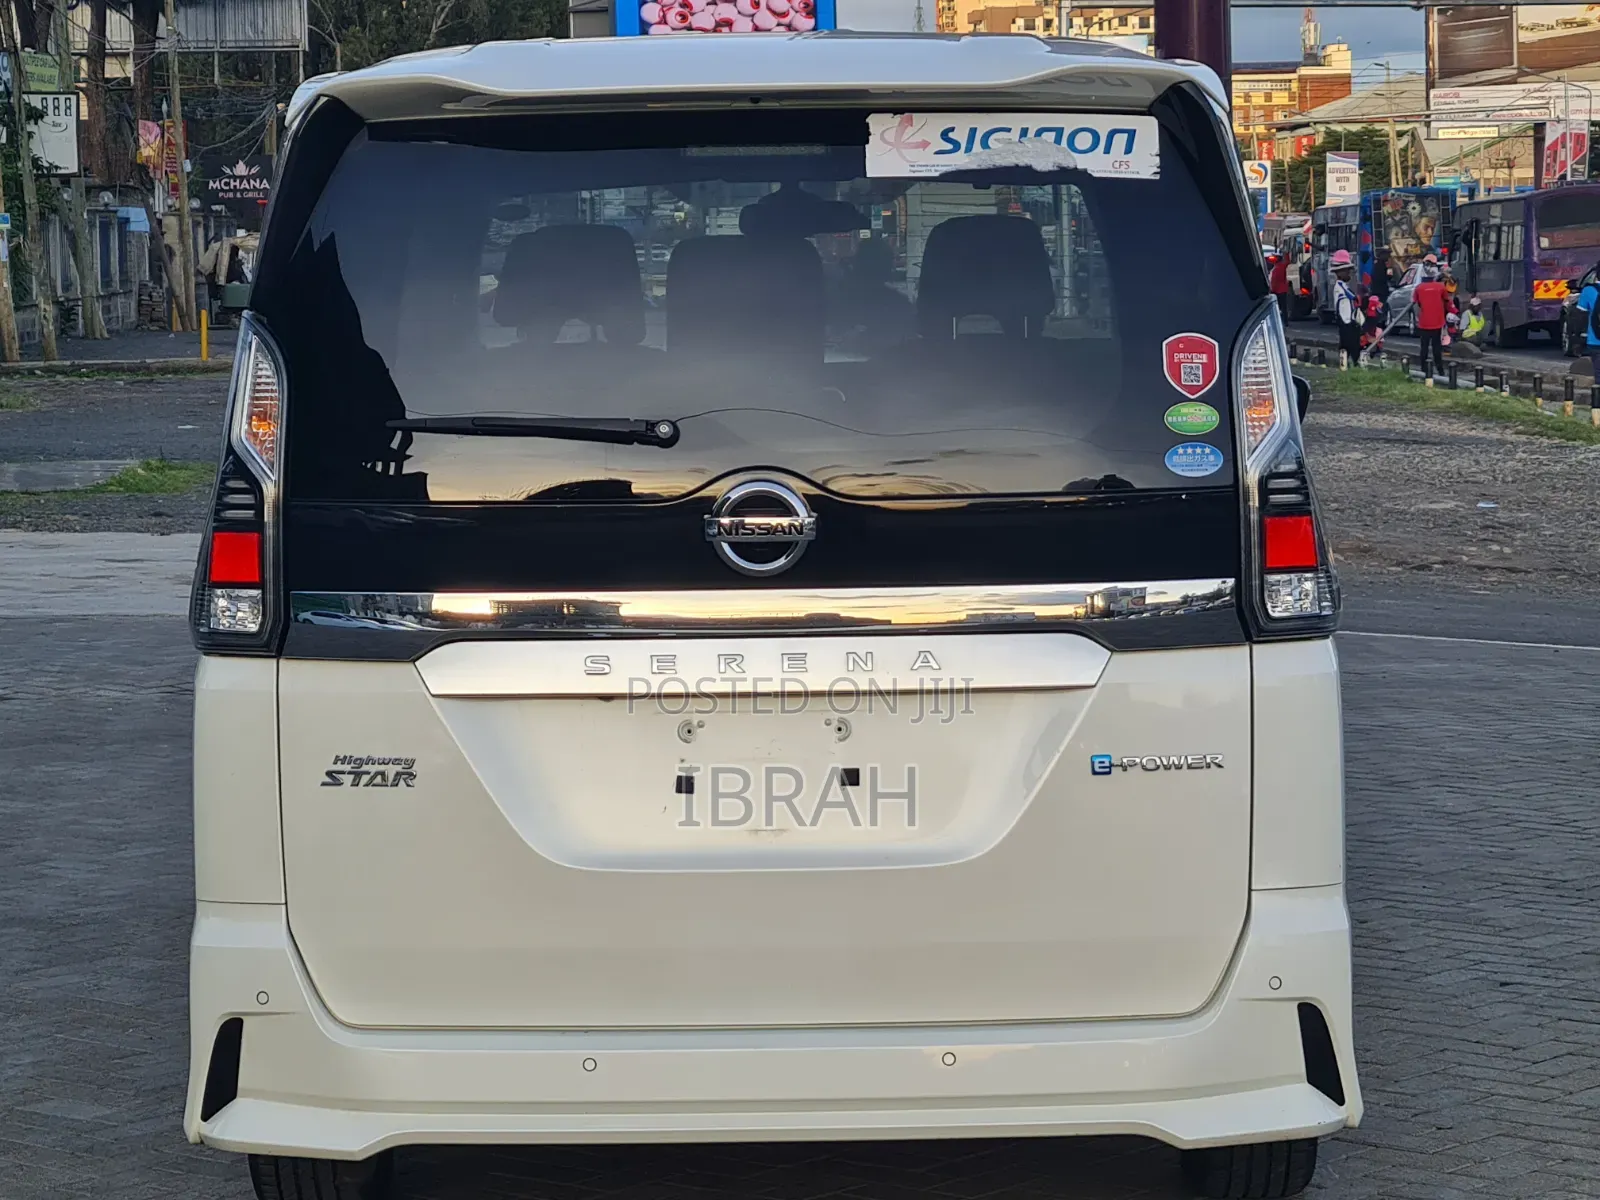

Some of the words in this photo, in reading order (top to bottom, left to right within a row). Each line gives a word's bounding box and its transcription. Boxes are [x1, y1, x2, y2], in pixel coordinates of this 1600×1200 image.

[1111, 160, 1131, 170] CFS
[208, 179, 270, 189] MCHANA
[718, 522, 804, 536] NISSAN
[583, 650, 942, 676] SERENA
[332, 754, 416, 770] Highway
[1091, 753, 1225, 776] e-POWER
[320, 770, 417, 788] STAR
